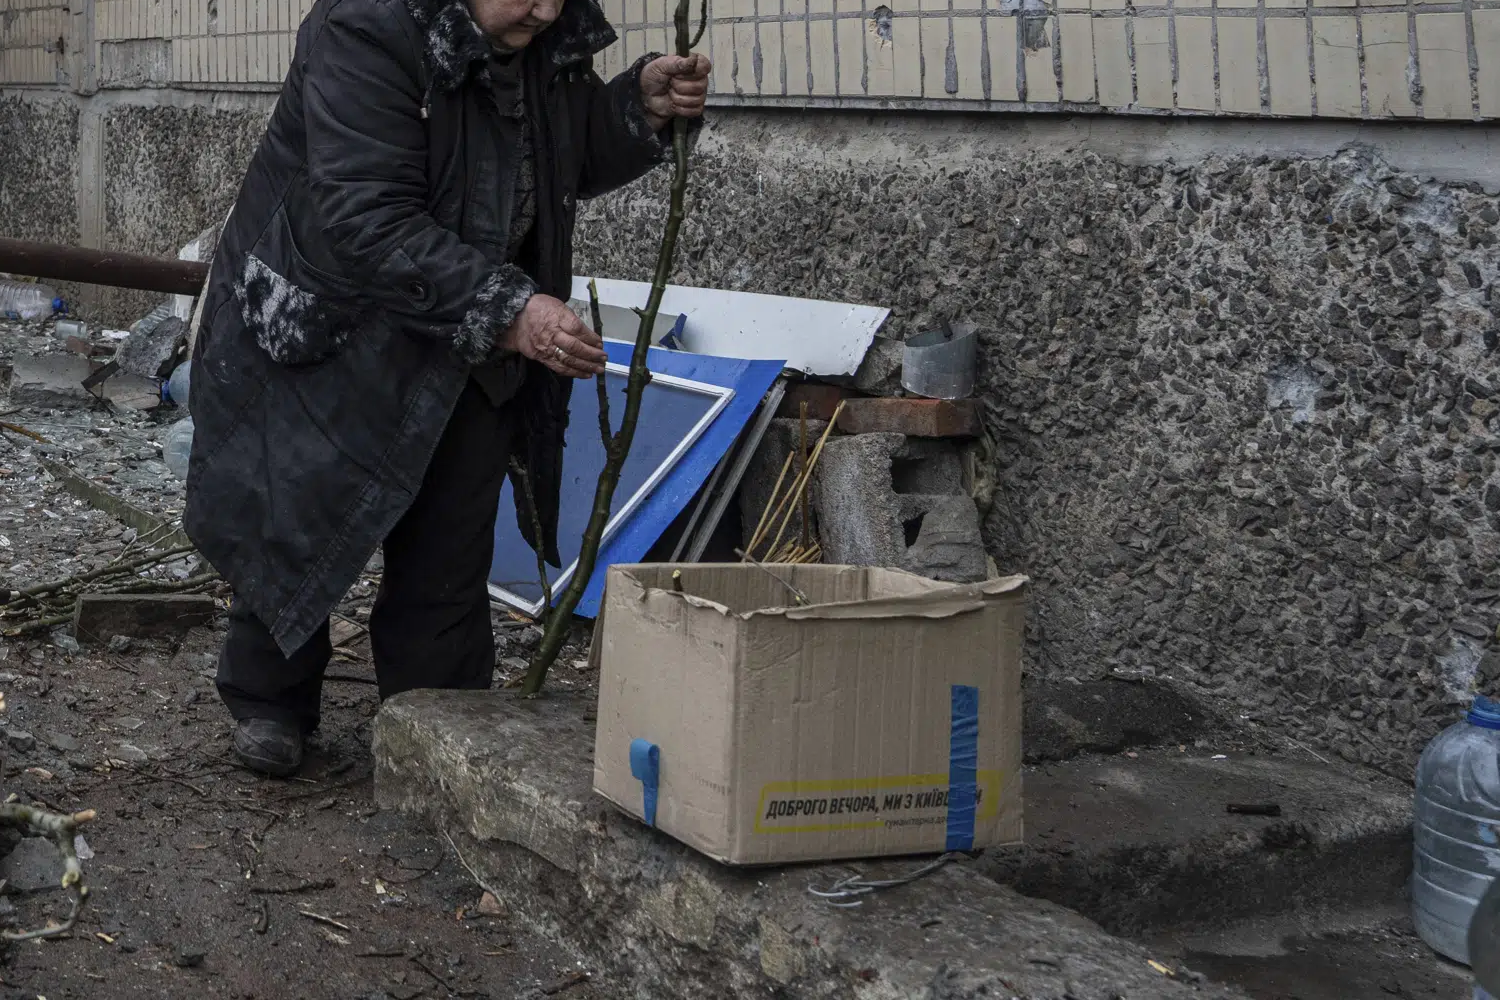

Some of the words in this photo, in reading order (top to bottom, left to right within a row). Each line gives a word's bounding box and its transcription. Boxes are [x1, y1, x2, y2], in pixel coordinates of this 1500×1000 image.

[765, 798, 828, 819] ДОБРОГО
[829, 795, 879, 814] ВЕЧОРА,
[882, 793, 903, 810] МИ
[904, 792, 913, 809] З
